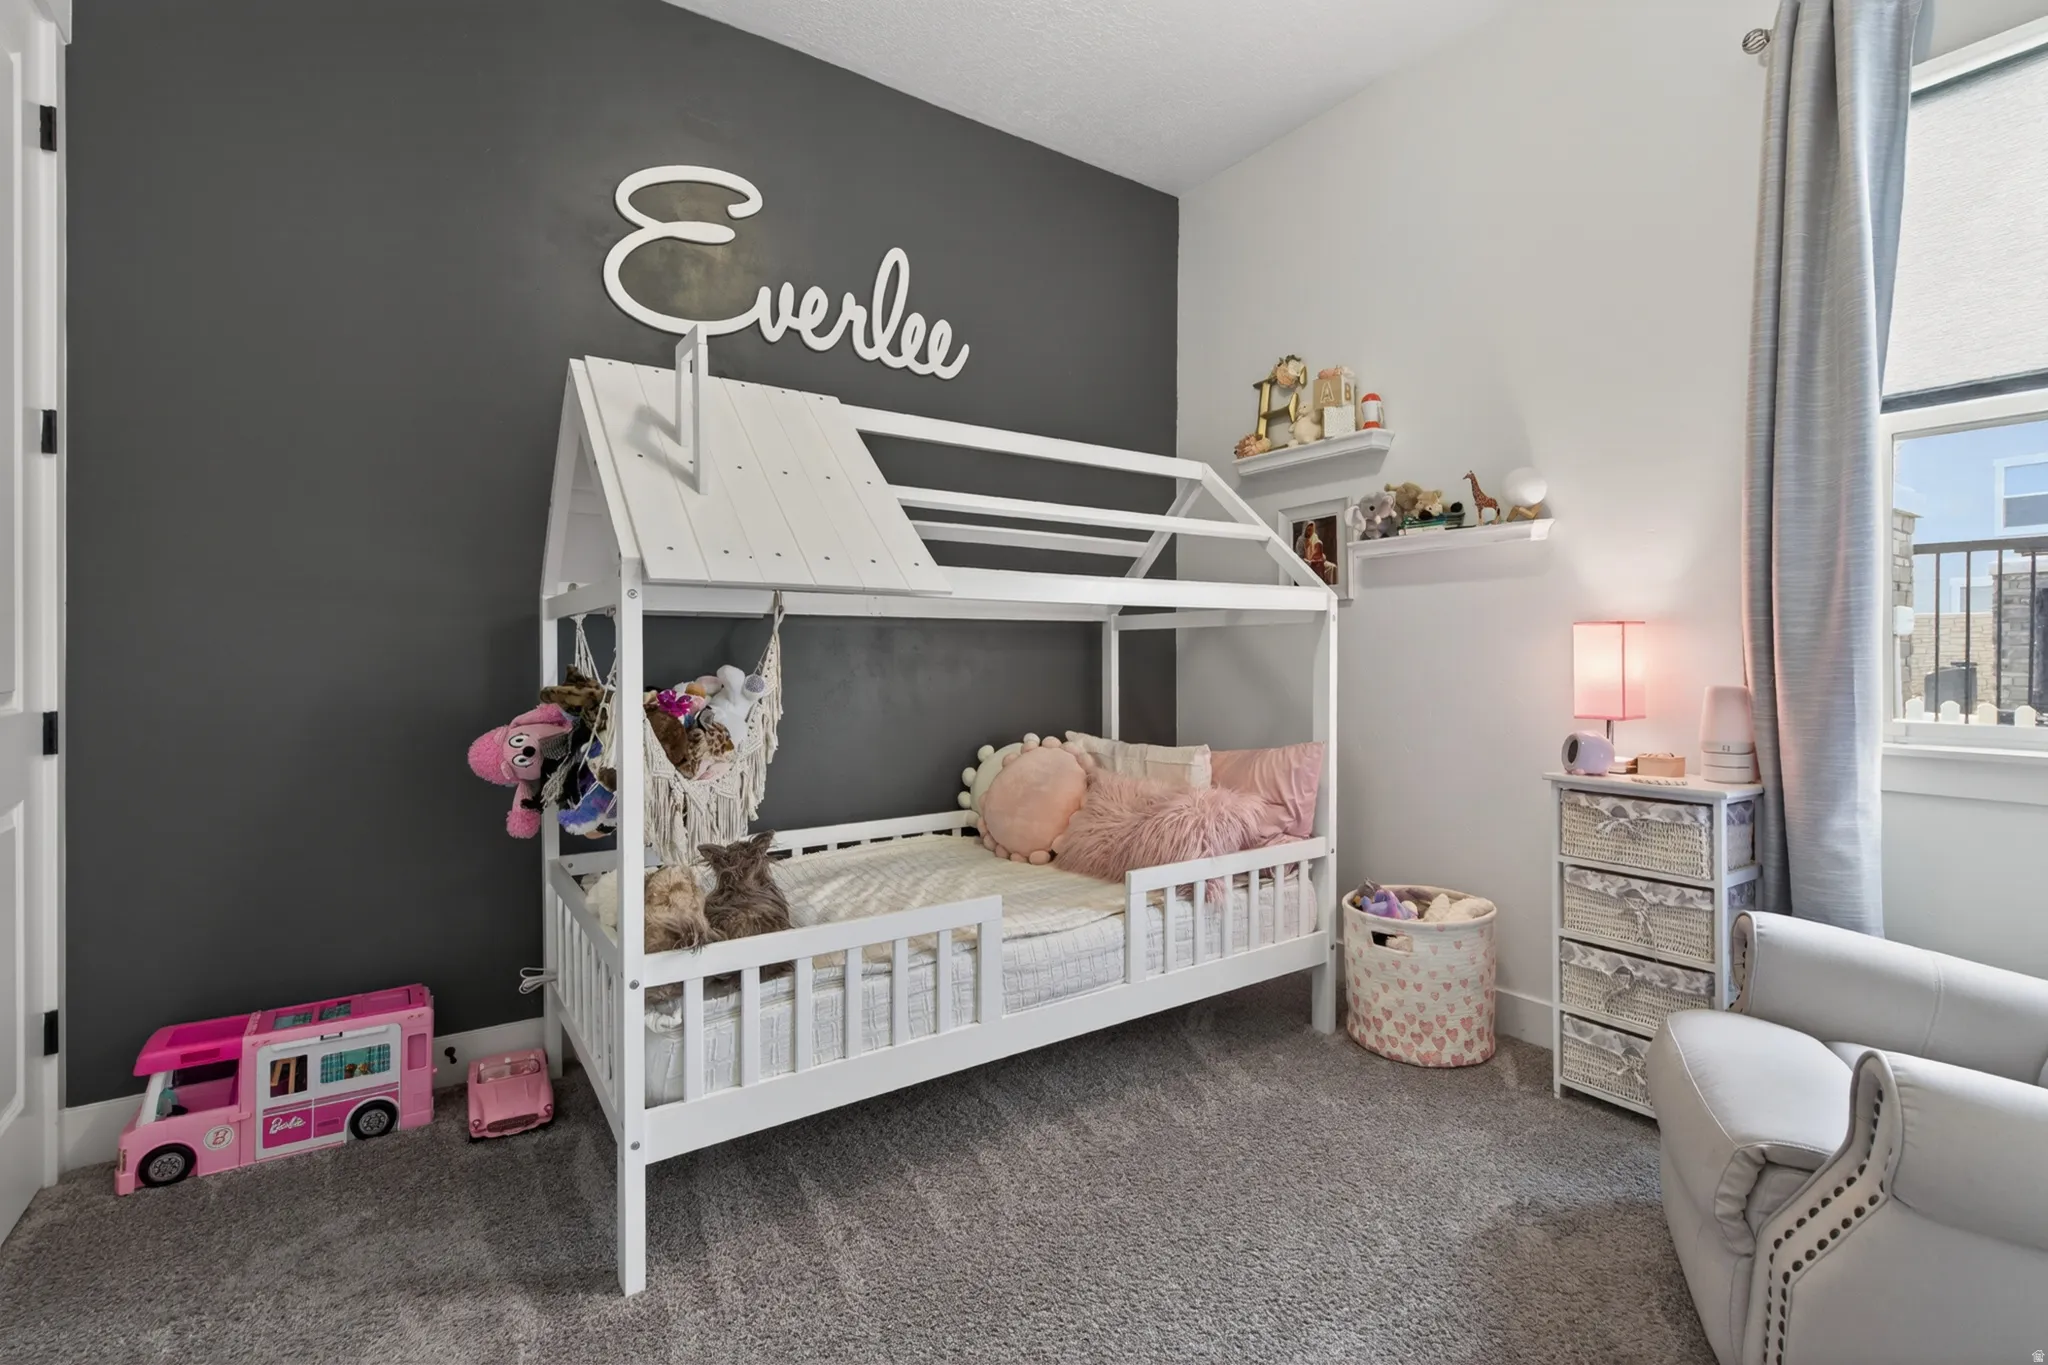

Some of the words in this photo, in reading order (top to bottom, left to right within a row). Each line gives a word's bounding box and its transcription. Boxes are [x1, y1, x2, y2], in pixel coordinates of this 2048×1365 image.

[603, 164, 970, 380] Everlee
[1320, 381, 1334, 403] A
[1344, 382, 1352, 401] B
[269, 1116, 306, 1134] Barbie
